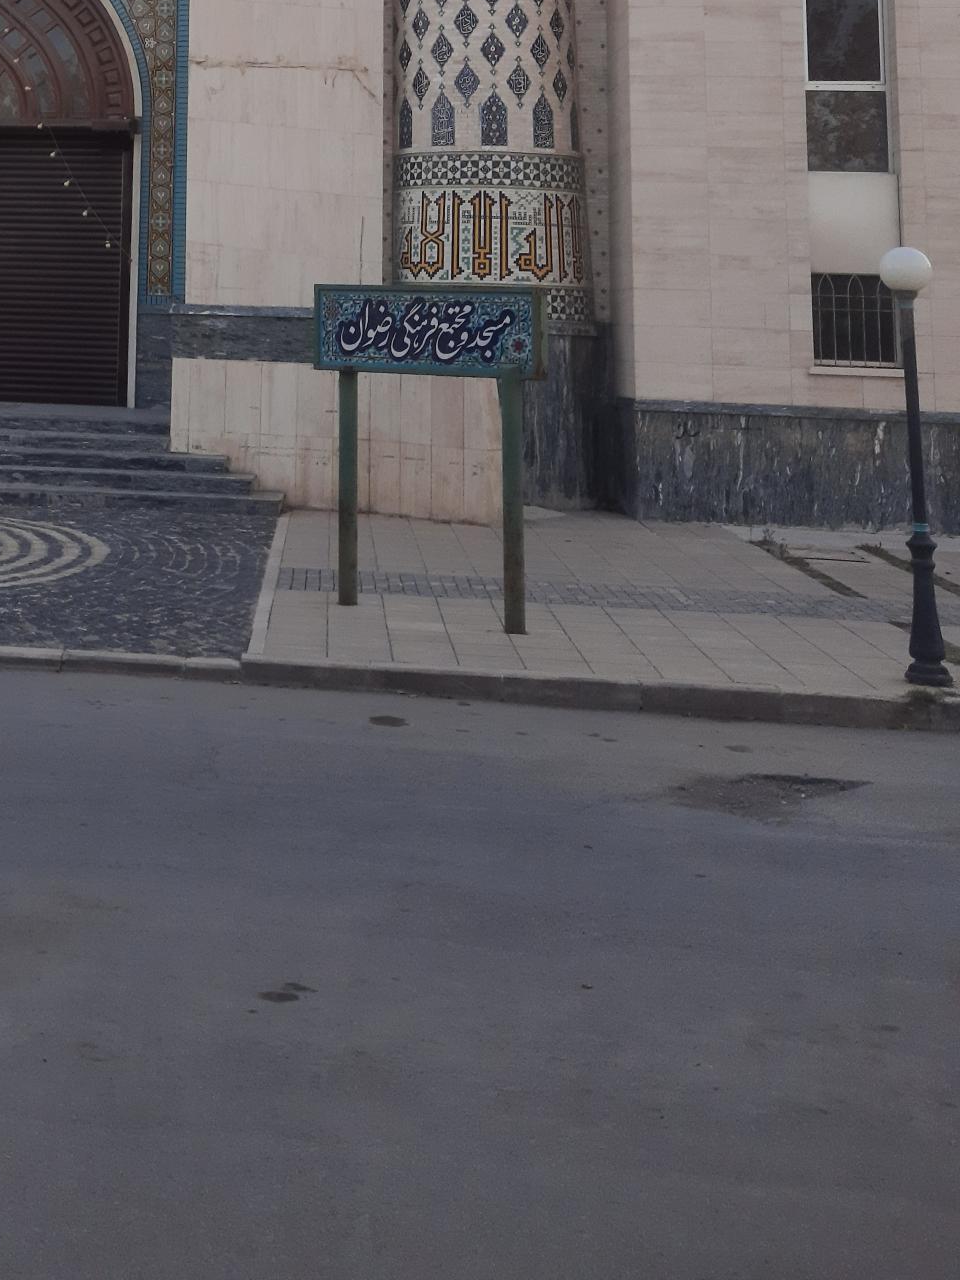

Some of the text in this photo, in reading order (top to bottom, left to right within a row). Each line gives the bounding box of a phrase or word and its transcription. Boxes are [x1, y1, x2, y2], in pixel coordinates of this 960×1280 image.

[340, 302, 392, 352] رضوان
[391, 303, 439, 357] فرهنگی
[435, 304, 472, 360] مجتمع
[466, 314, 511, 358] مسجد
